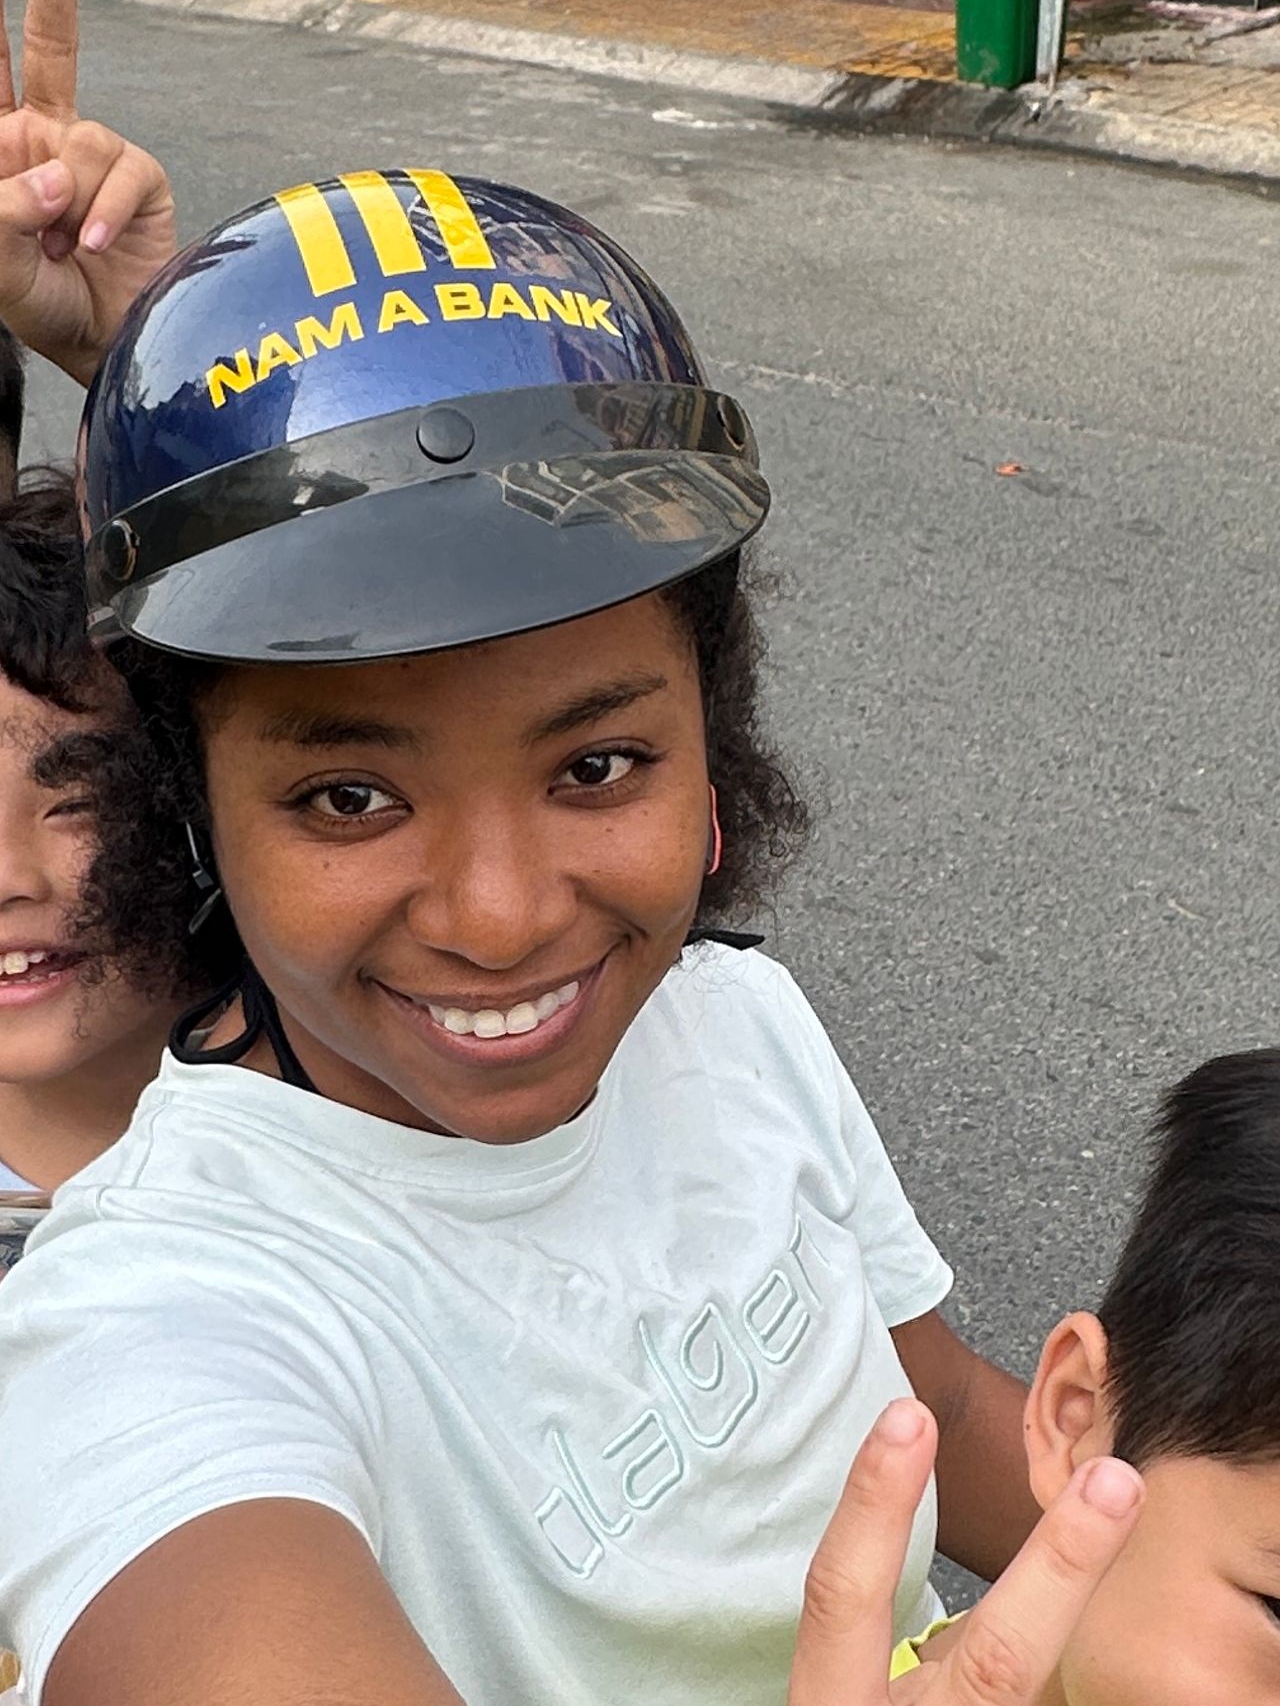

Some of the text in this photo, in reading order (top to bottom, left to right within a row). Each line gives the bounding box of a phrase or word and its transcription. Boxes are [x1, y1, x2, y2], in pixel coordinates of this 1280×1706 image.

[205, 283, 622, 409] NAM A BANK
